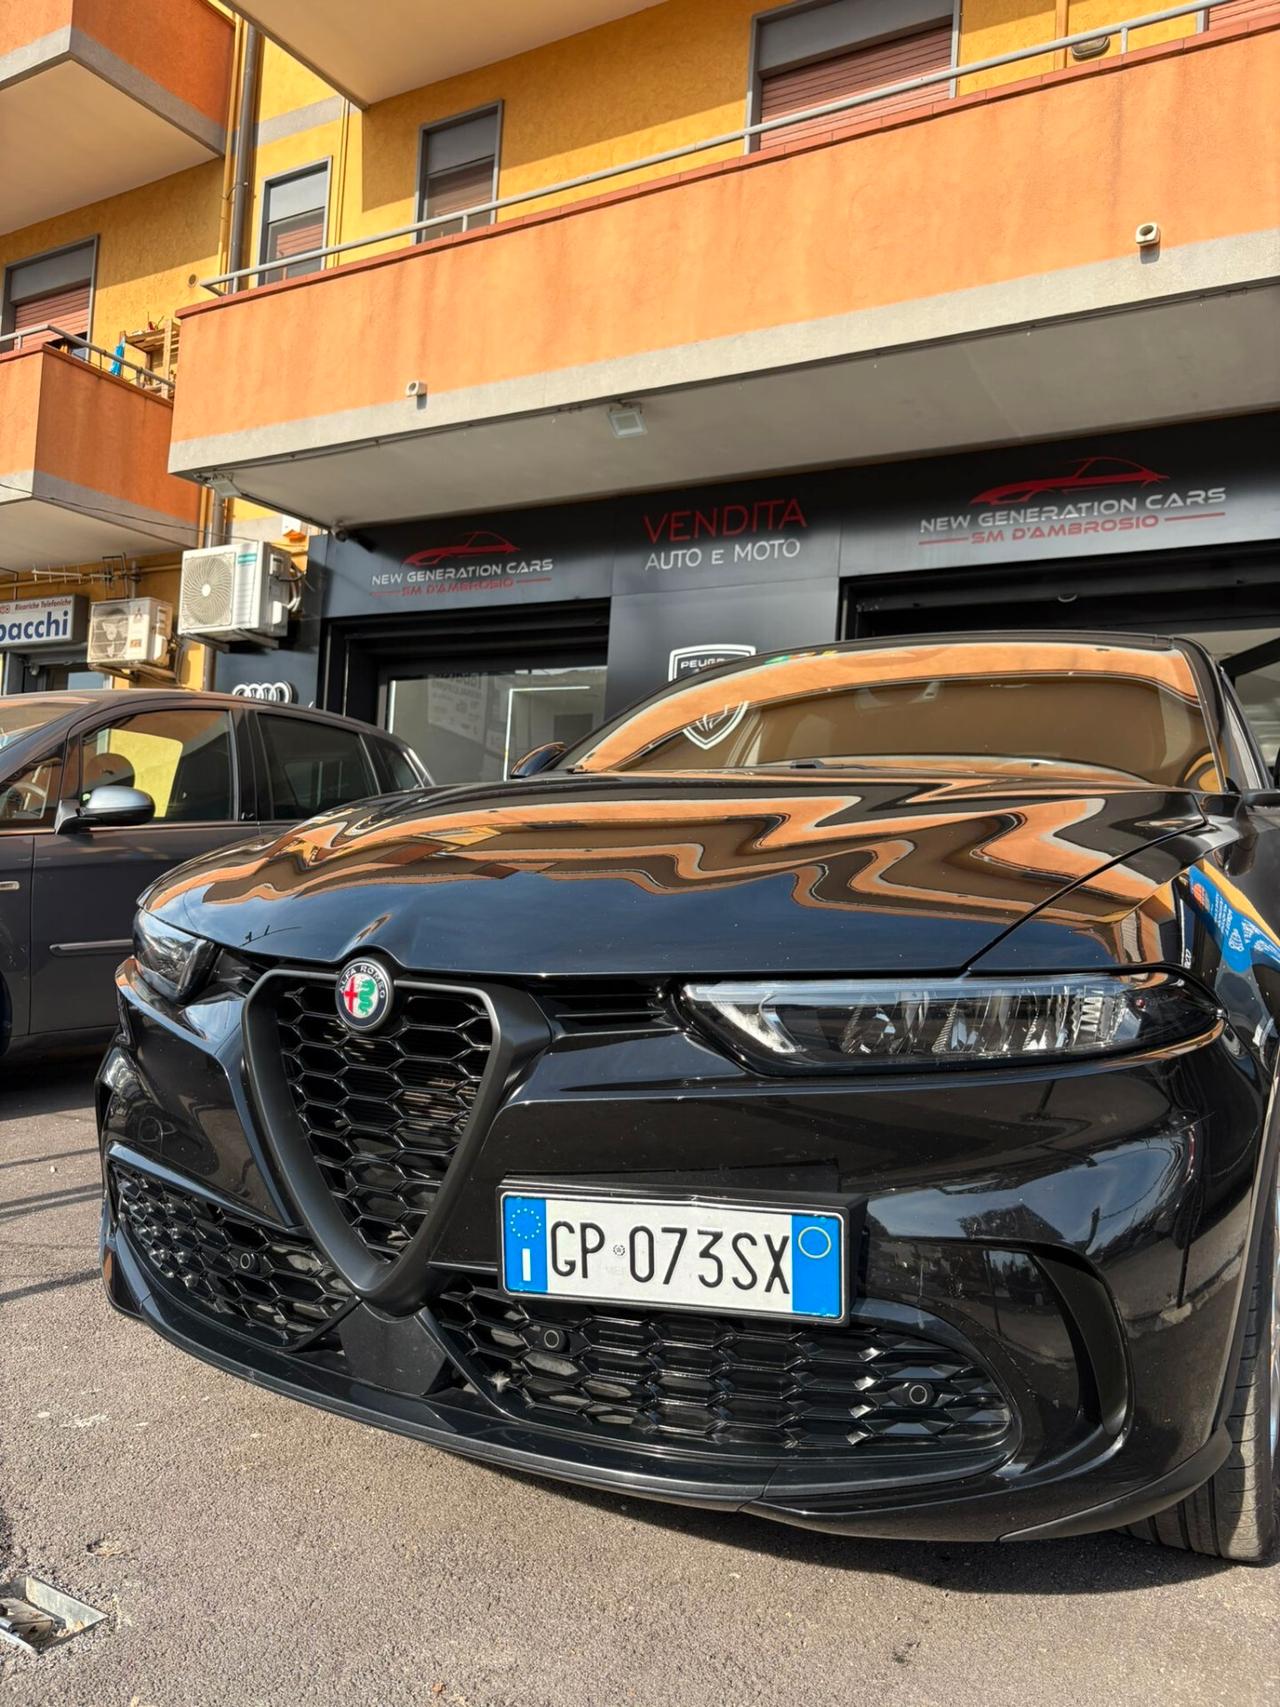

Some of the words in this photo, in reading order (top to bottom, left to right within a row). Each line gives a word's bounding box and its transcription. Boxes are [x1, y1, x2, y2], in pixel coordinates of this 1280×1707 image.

[643, 498, 809, 544] VENDITA
[920, 514, 970, 533] NEW
[977, 497, 1138, 527] GENERATION
[1145, 487, 1227, 510] CARS
[971, 530, 1004, 545] SM
[1011, 513, 1160, 541] D'AMBROSIO
[644, 547, 703, 571] AUTO
[711, 549, 725, 565] E
[734, 538, 801, 563] MOTO
[371, 573, 403, 586] NEW
[406, 563, 502, 583] GENERATION
[506, 558, 554, 574] CARS
[401, 585, 423, 597] SM
[427, 577, 515, 597] D'AMBROSIO
[41, 599, 72, 608] Telefoniche
[339, 967, 357, 994] ALFA
[359, 965, 386, 999] ROMEO
[550, 1219, 606, 1280] GP
[627, 1224, 791, 1295] 073SX
